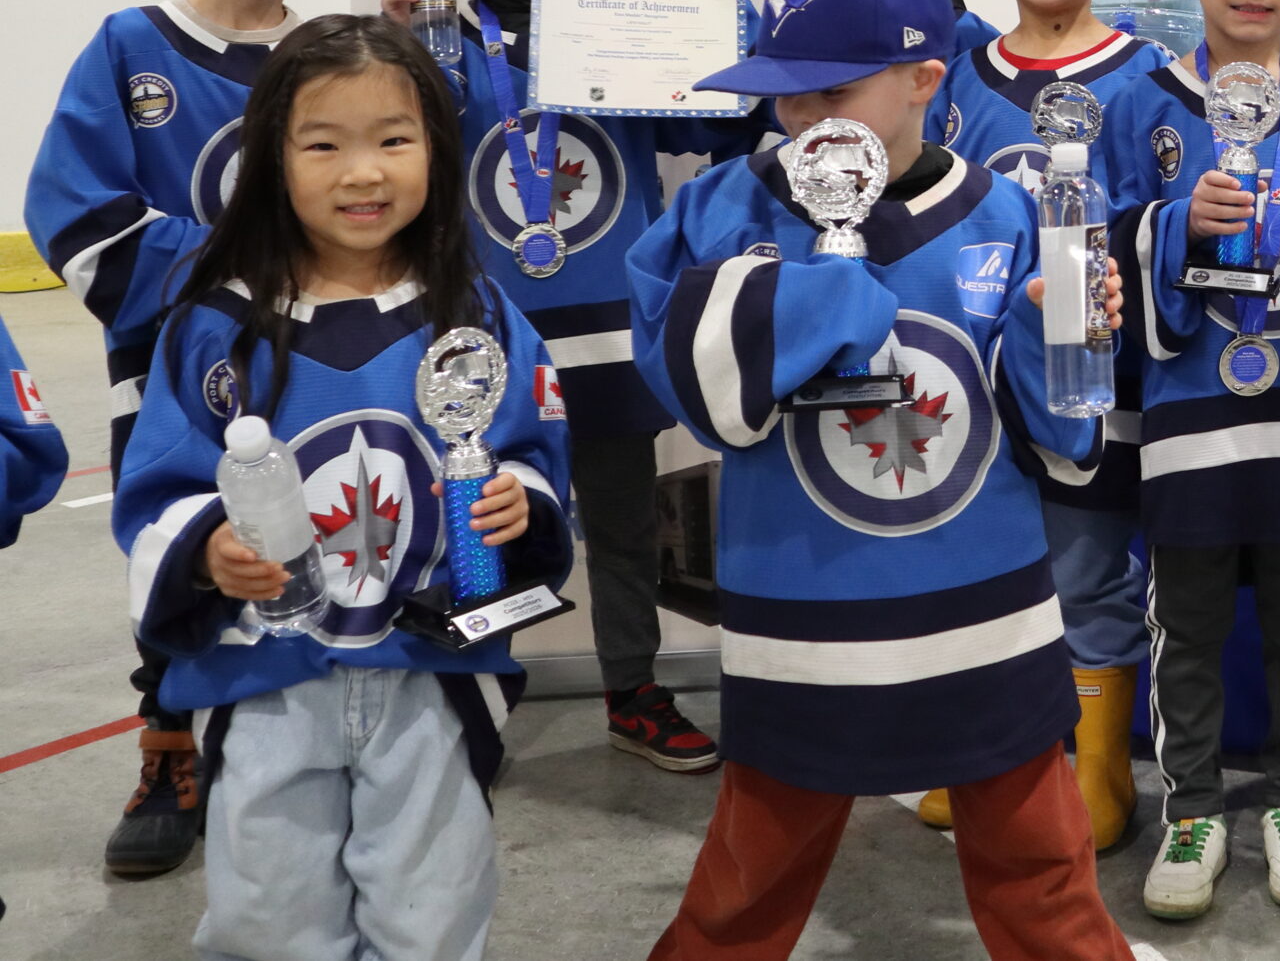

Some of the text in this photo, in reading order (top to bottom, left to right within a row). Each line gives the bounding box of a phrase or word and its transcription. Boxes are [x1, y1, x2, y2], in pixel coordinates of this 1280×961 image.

[628, 0, 639, 10] of
[641, 1, 700, 15] Achievement
[141, 77, 170, 92] CREDIT
